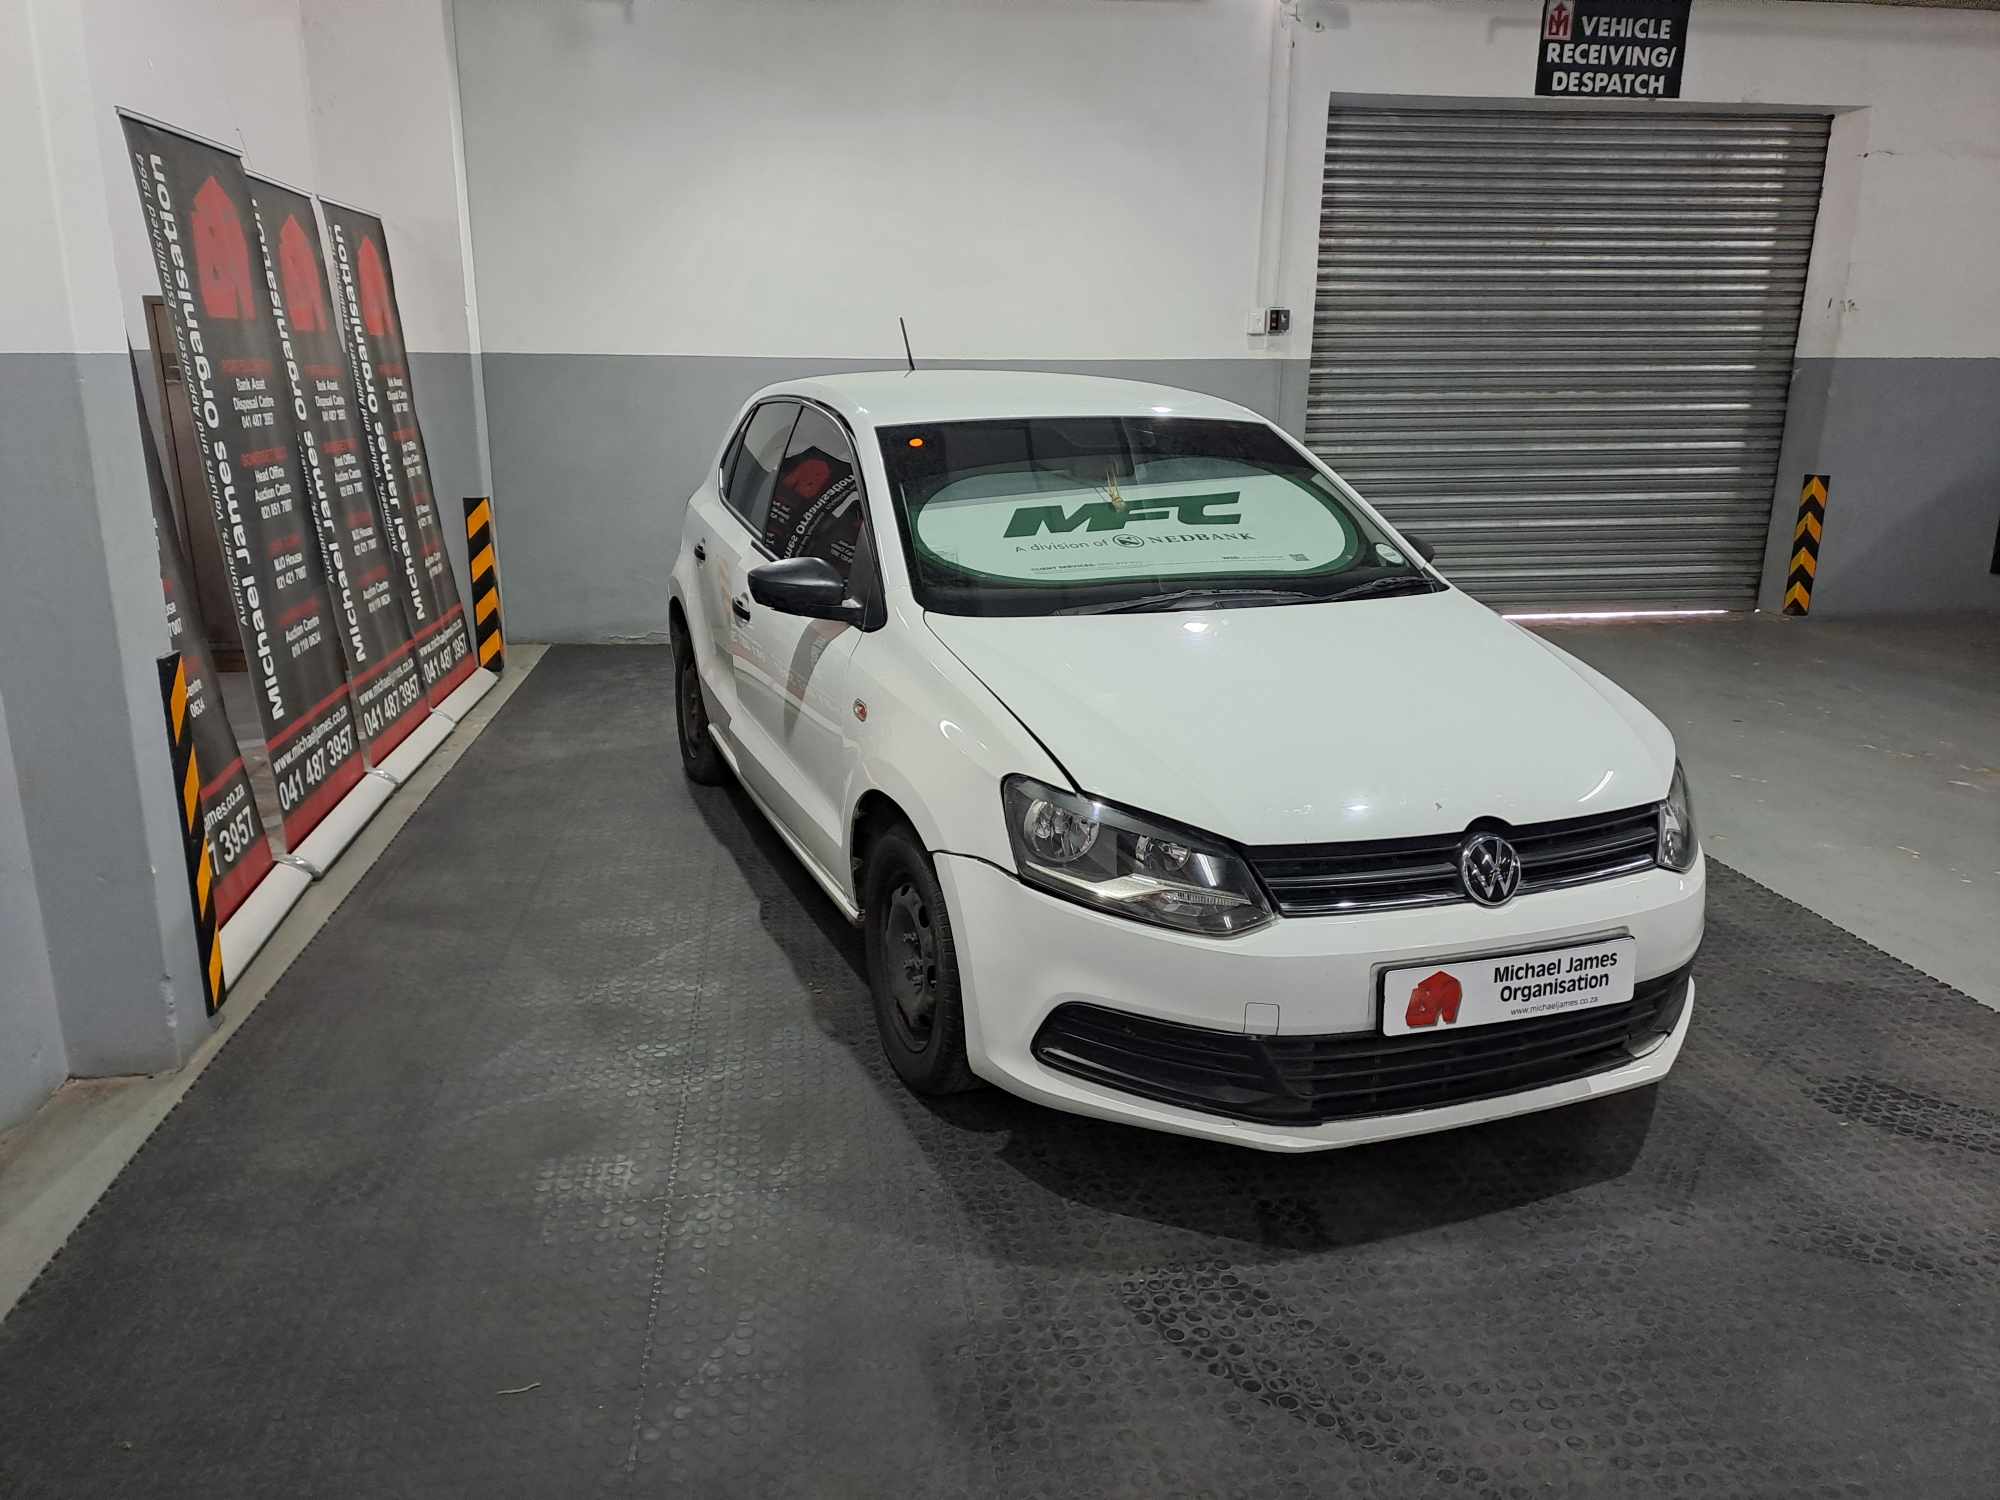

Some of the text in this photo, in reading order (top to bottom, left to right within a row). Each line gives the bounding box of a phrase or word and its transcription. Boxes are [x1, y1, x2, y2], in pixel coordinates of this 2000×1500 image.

[1546, 43, 1677, 68] RECEIVING/
[1582, 16, 1672, 40] VEHICLE
[1551, 71, 1665, 95] DESPATCH
[135, 152, 153, 198] 1964
[147, 203, 177, 309] Established
[334, 224, 379, 413] Organisation
[176, 325, 201, 418] Appraisers
[150, 153, 285, 721] Michael James Organisation
[195, 421, 210, 454] and
[360, 407, 371, 432] and
[206, 460, 224, 521] Valuers
[303, 430, 335, 534] James
[374, 421, 400, 510] James
[1003, 491, 1241, 539] MFC
[1015, 532, 1256, 553] A division of NEDBANK
[222, 527, 249, 626] Auctioneers,
[393, 517, 426, 620] Michael
[328, 542, 367, 663] Michael
[423, 632, 468, 684] 041 487 3957
[363, 673, 421, 737] 041 487 3957
[279, 723, 353, 811] 041 487 3957
[219, 804, 255, 863] 3957
[1494, 952, 1618, 984] Michael James
[1500, 973, 1609, 1003] Organisation
[1510, 995, 1600, 1017] www.michaeljames.co.za
